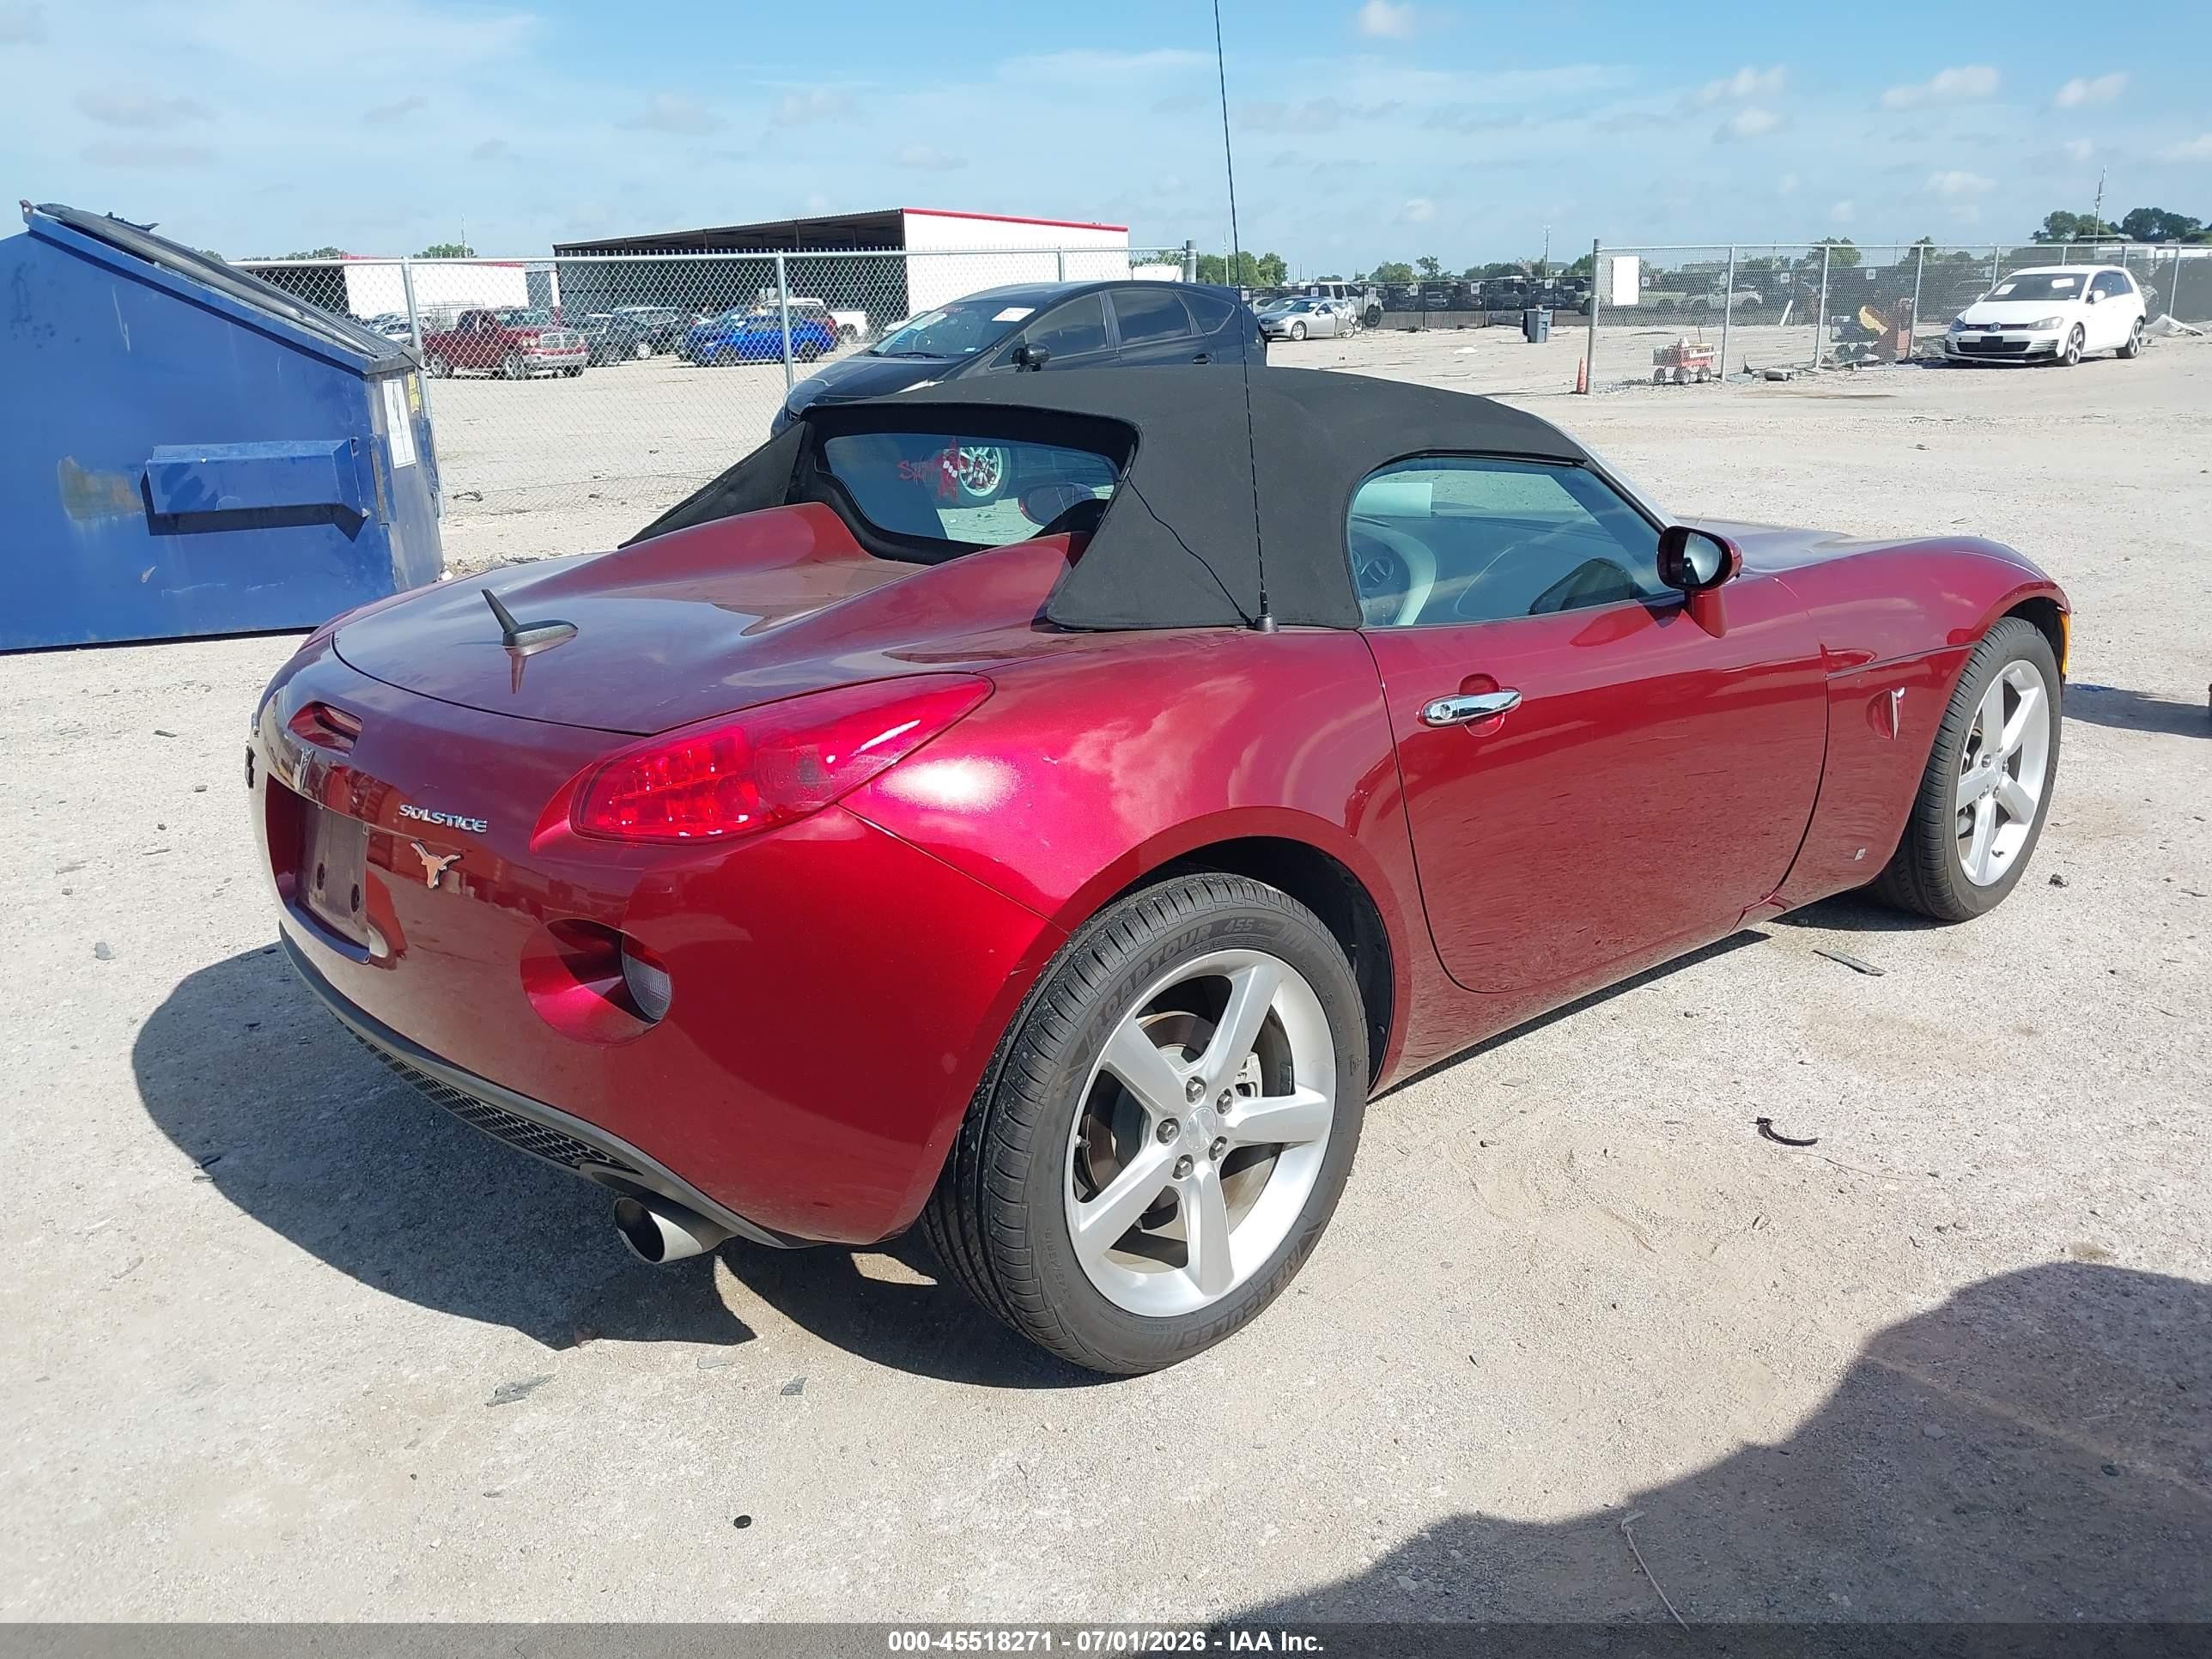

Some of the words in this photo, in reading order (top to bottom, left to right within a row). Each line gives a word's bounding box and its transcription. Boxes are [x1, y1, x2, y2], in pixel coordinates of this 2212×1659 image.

[398, 803, 488, 834] SOLSTICE
[1085, 921, 1212, 1042] ROADTOUR
[1224, 918, 1254, 933] 455
[1180, 1250, 1300, 1348] HERCULES
